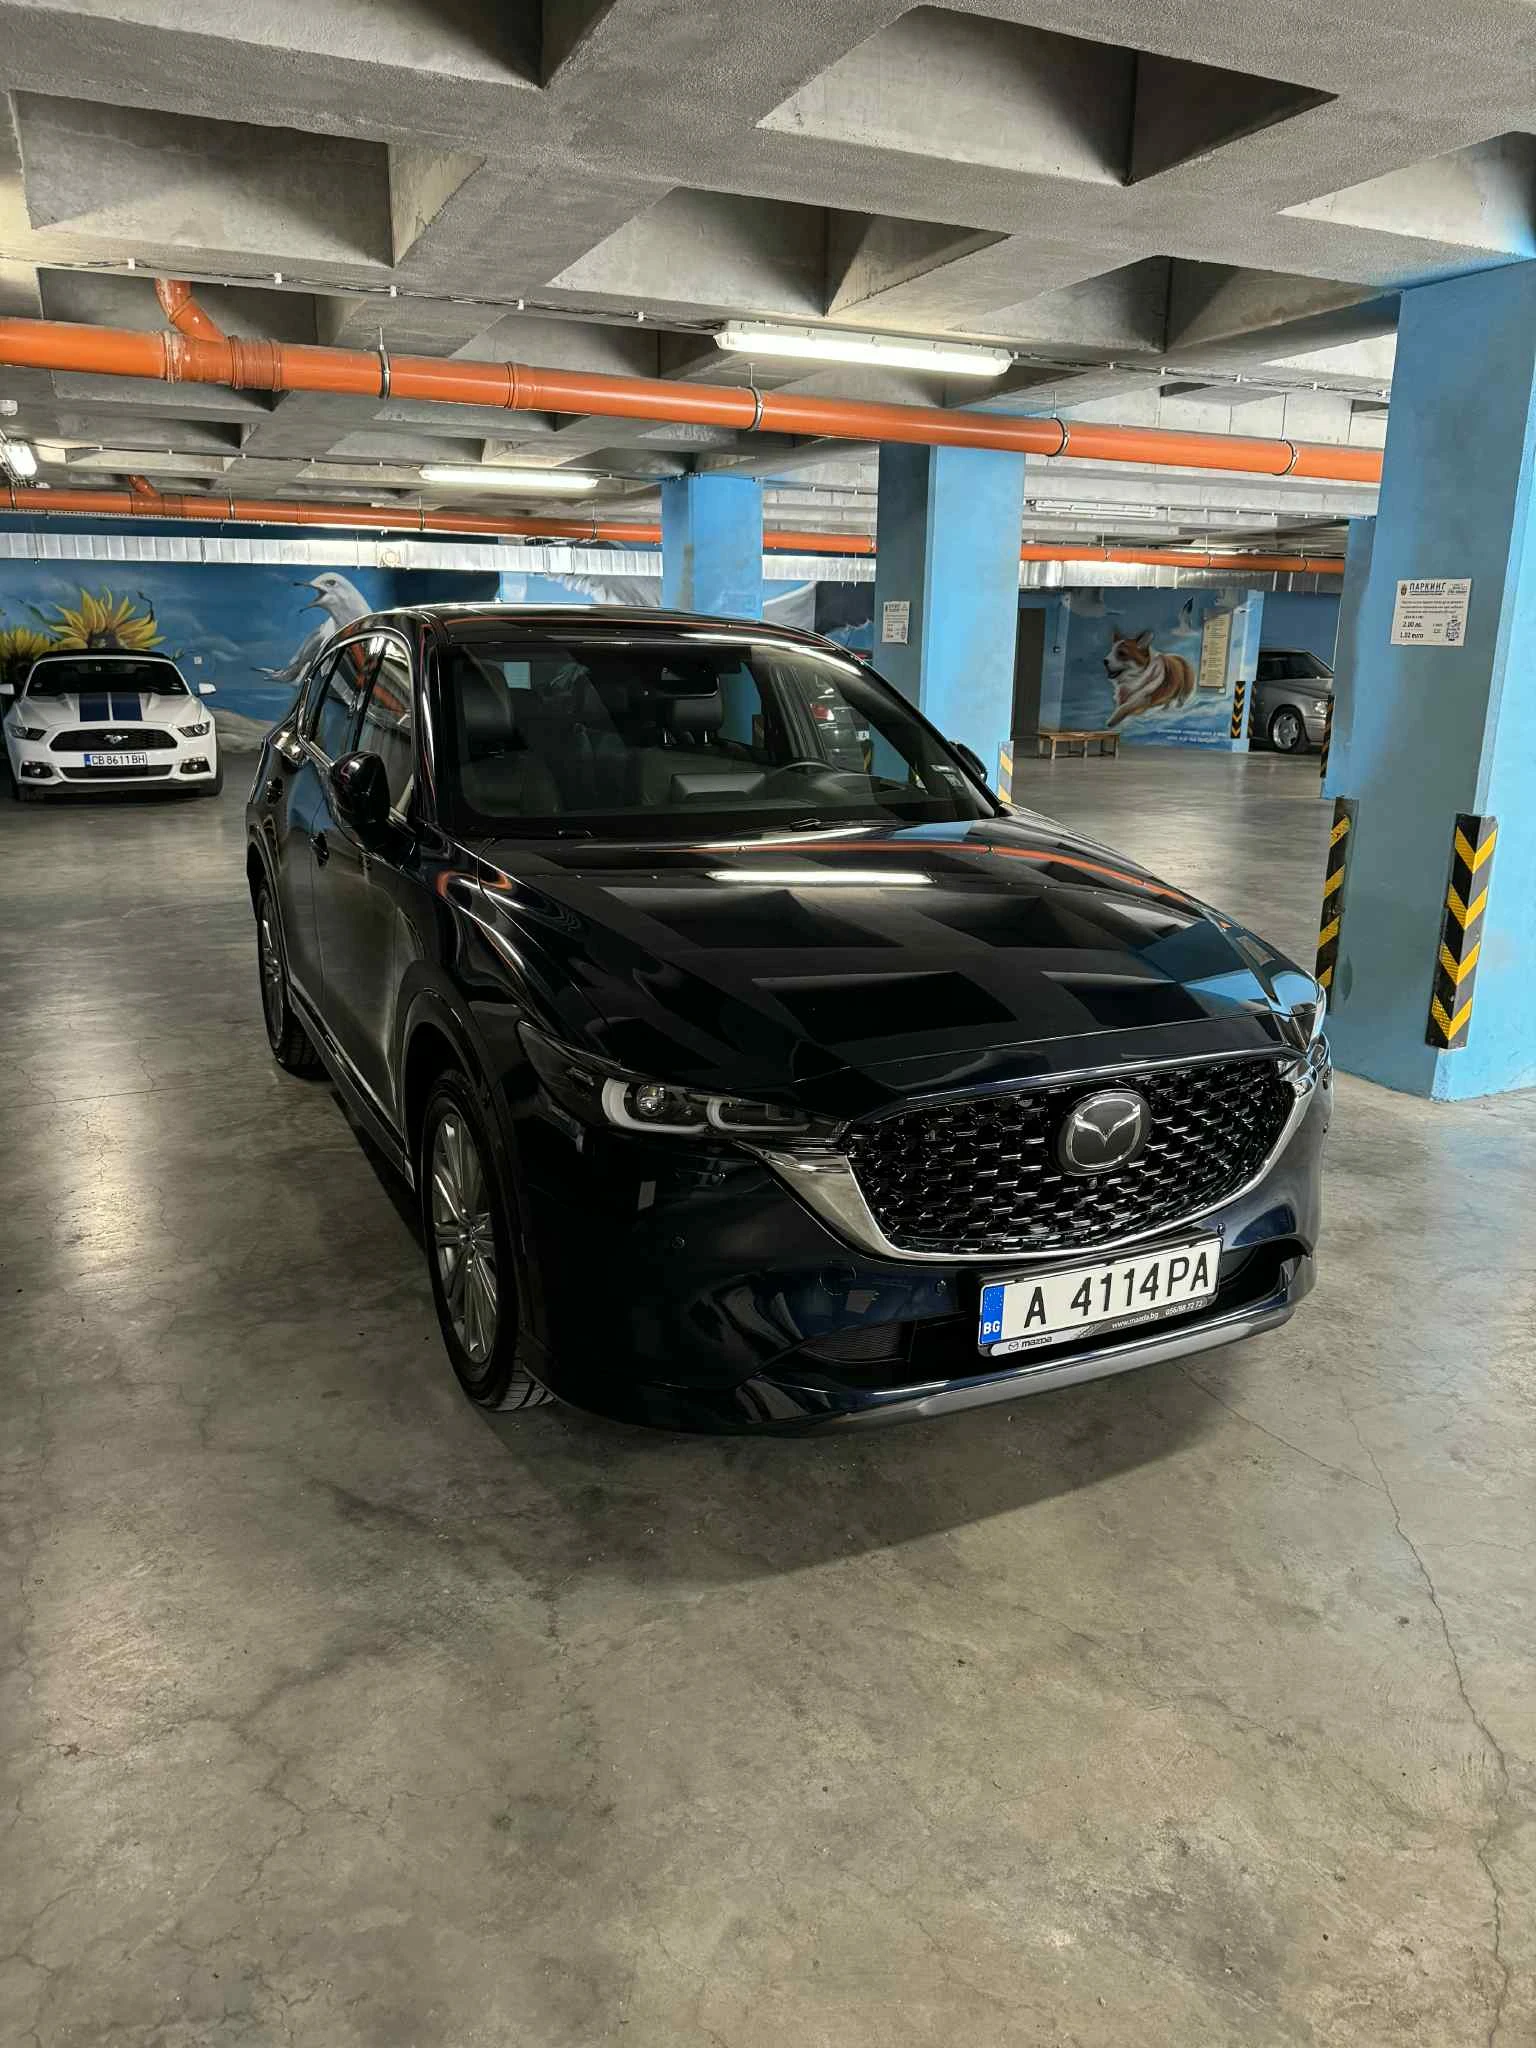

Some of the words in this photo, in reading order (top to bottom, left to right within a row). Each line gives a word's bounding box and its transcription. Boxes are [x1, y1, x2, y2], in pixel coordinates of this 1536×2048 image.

[1409, 582, 1447, 591] ПАРКИНГ
[91, 755, 105, 765] CB
[106, 755, 130, 765] 8611
[131, 755, 145, 764] BH
[1023, 1286, 1047, 1328] A
[1070, 1252, 1209, 1316] 4114PA
[1112, 1312, 1159, 1329] www.mazda.bg
[983, 1321, 1001, 1334] BG
